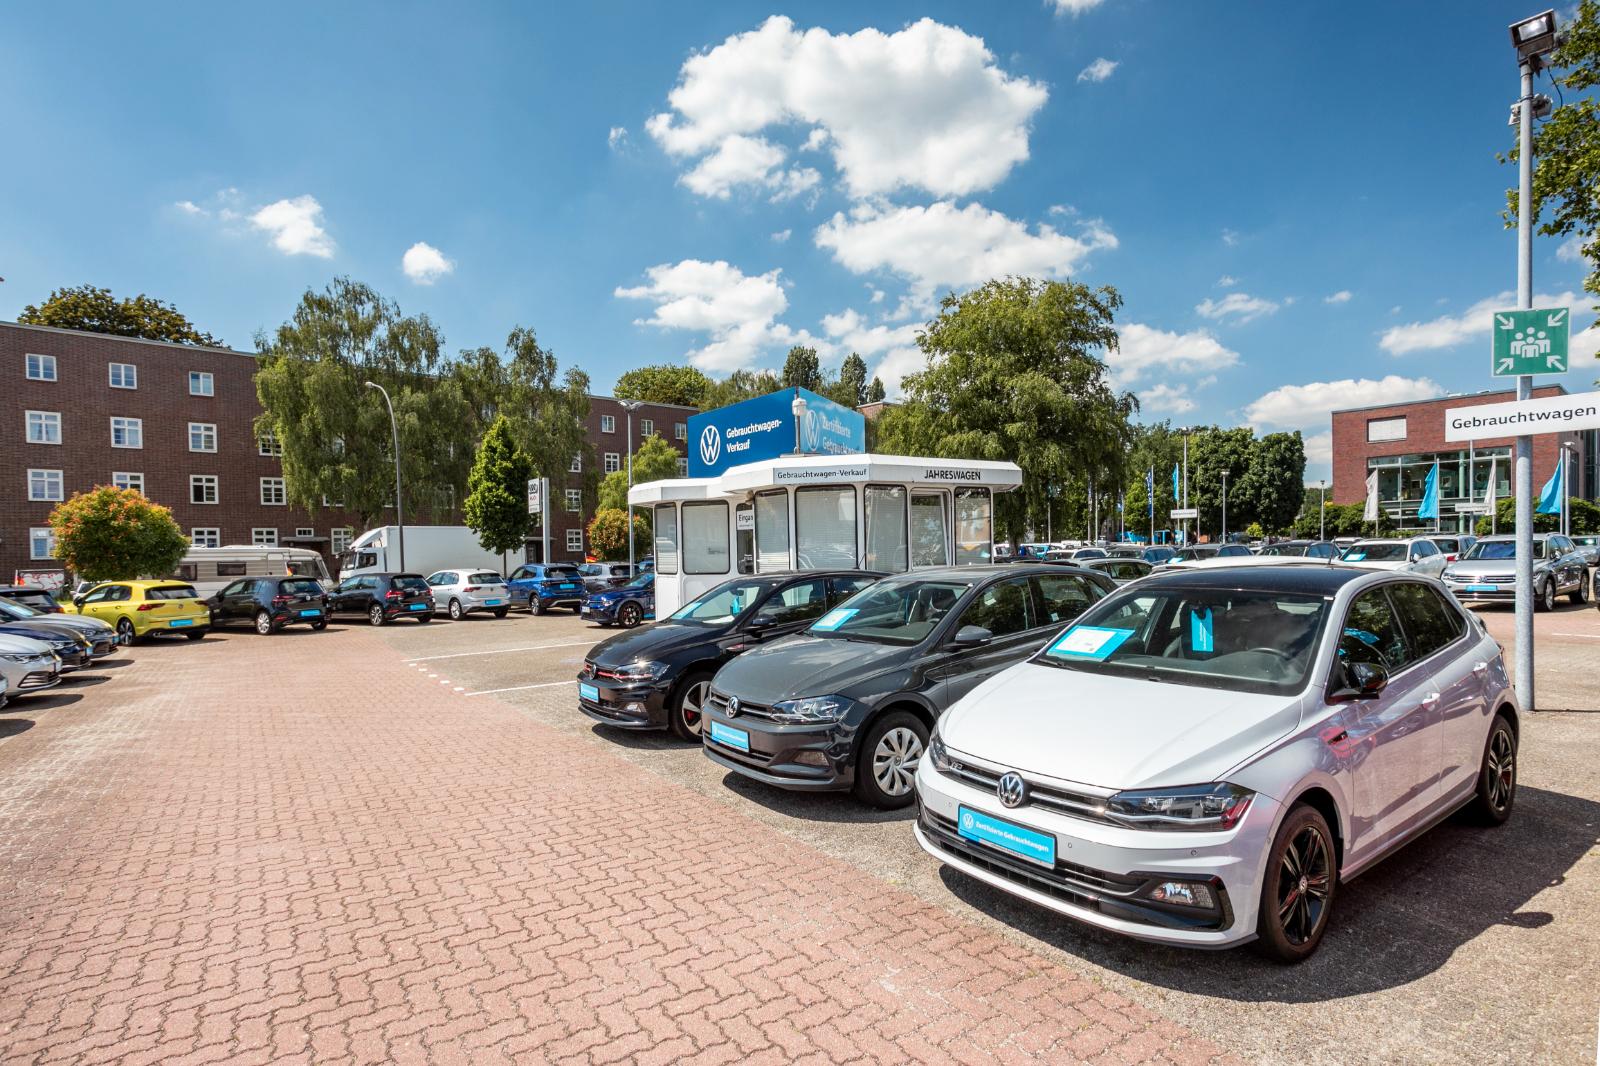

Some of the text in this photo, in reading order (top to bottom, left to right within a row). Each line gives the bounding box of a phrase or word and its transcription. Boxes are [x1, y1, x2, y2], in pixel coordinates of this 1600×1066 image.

[1452, 406, 1597, 429] Gebrauchtwagen
[726, 418, 783, 439] Gebrauchtwagen-
[700, 425, 721, 466] VW
[726, 439, 750, 453] Verkauf
[777, 469, 867, 479] Gebrauchtwagen-Verkauf
[924, 469, 981, 481] JAHRESWAGEN
[1003, 830, 1049, 853] Gebrauchtwagen
